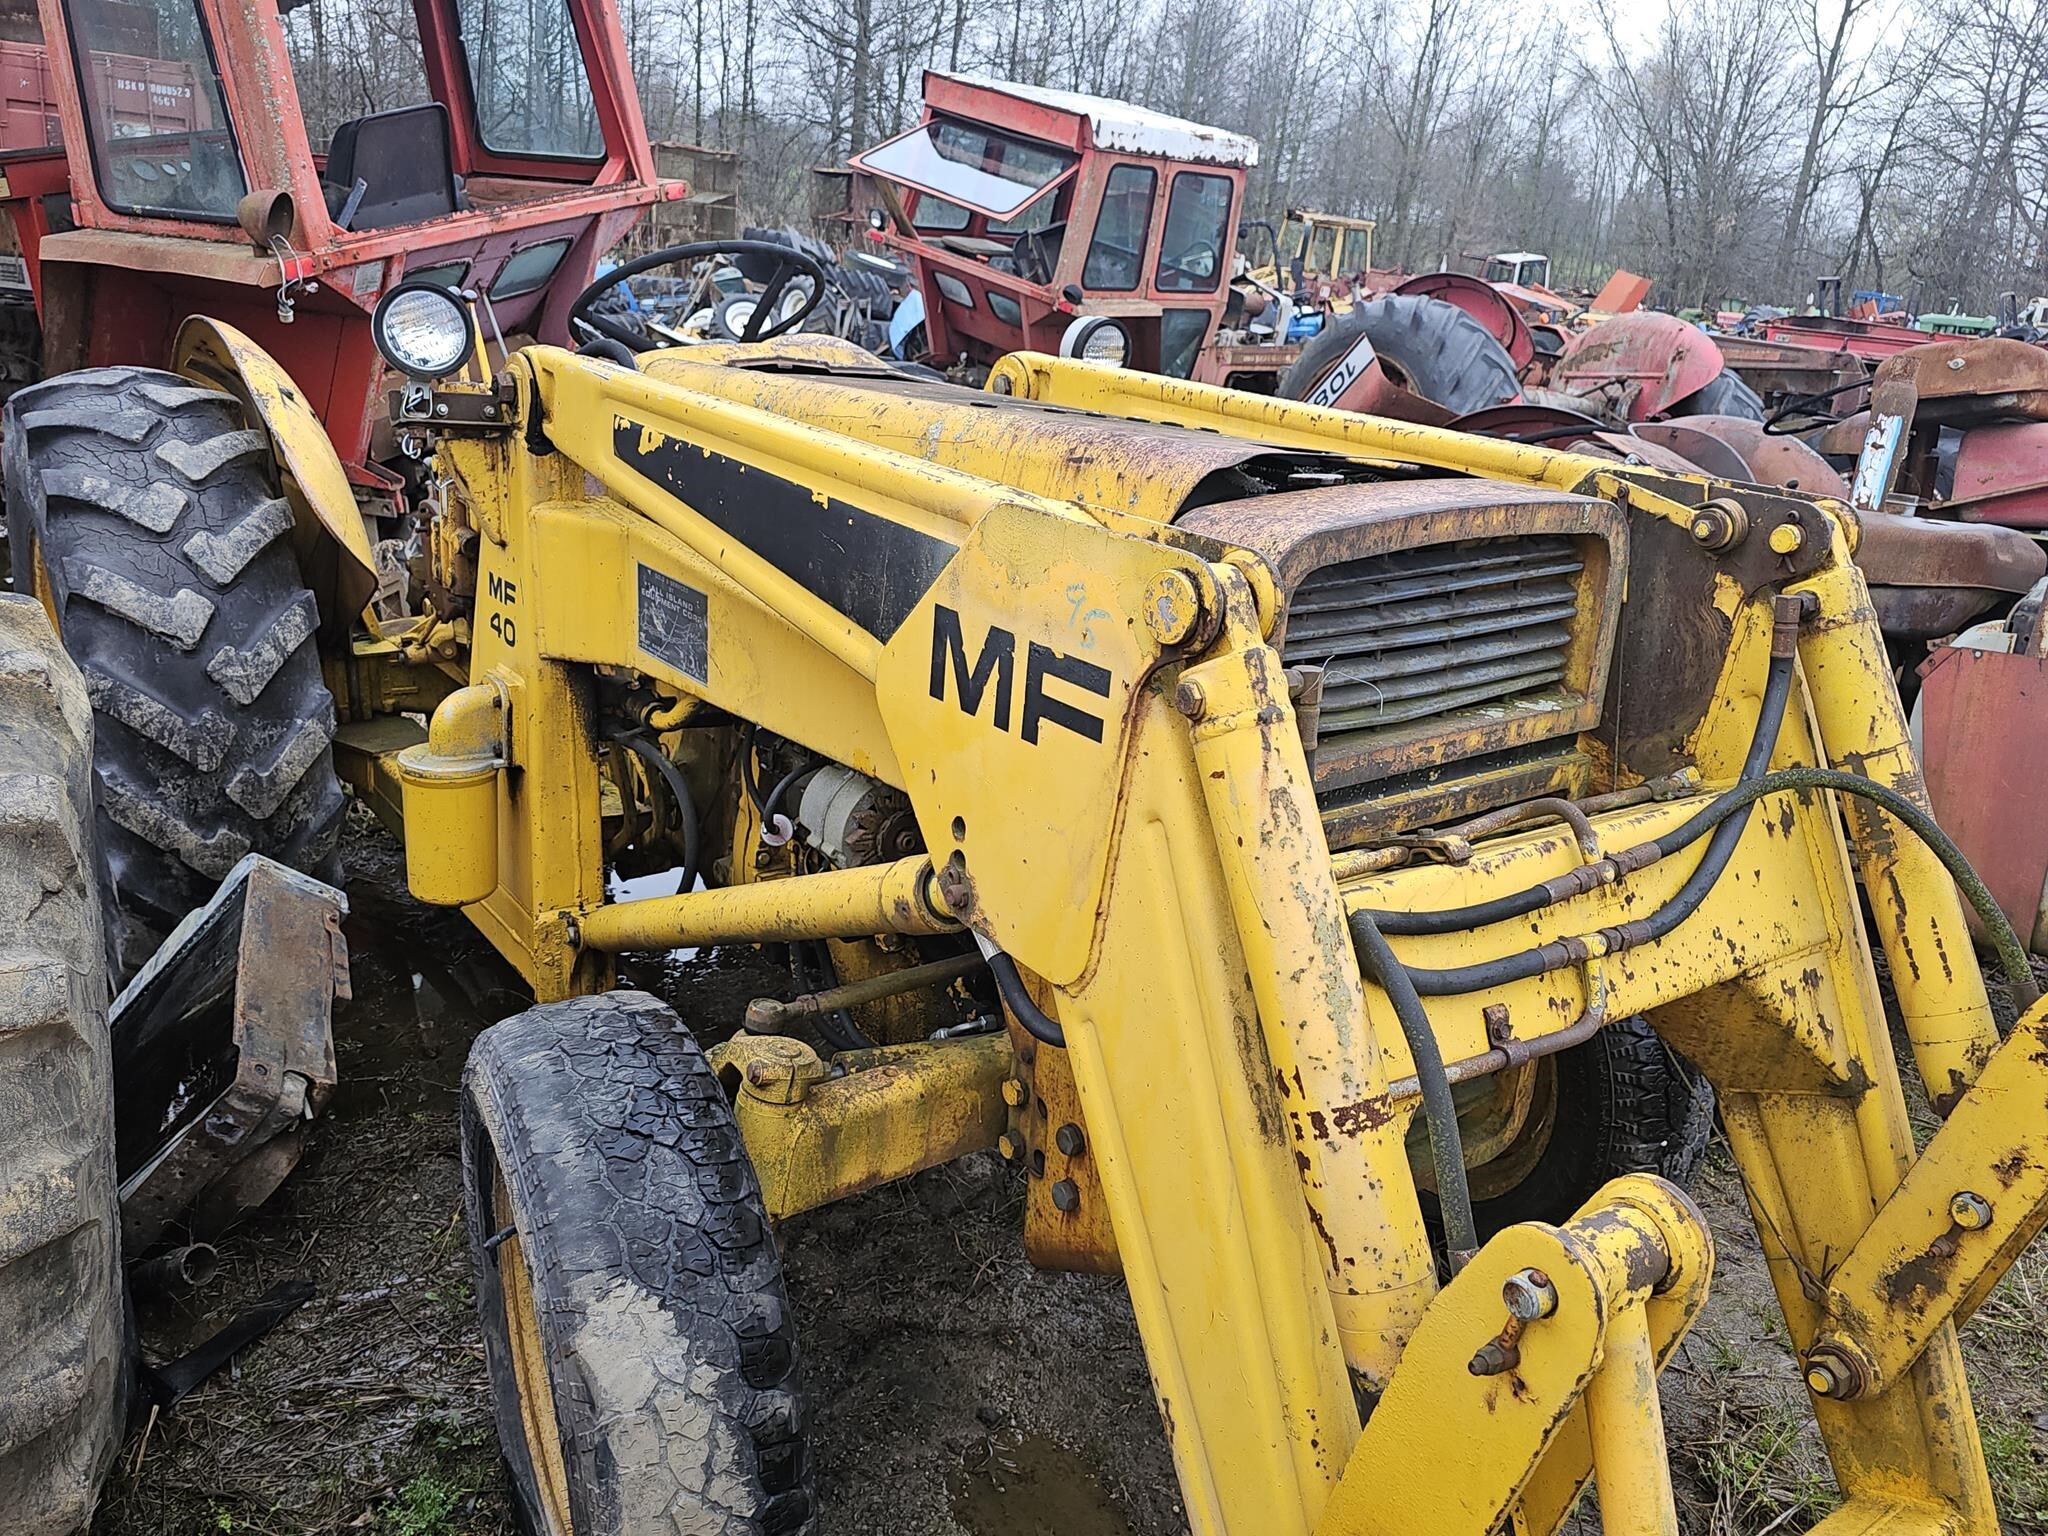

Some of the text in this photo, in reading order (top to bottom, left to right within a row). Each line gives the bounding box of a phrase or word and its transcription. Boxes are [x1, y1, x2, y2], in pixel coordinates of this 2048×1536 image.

[489, 571, 516, 606] MF
[641, 588, 680, 613] EQUIPMENT
[665, 592, 693, 612] ISLAND
[490, 612, 516, 647] 40
[929, 602, 1112, 747] MF
